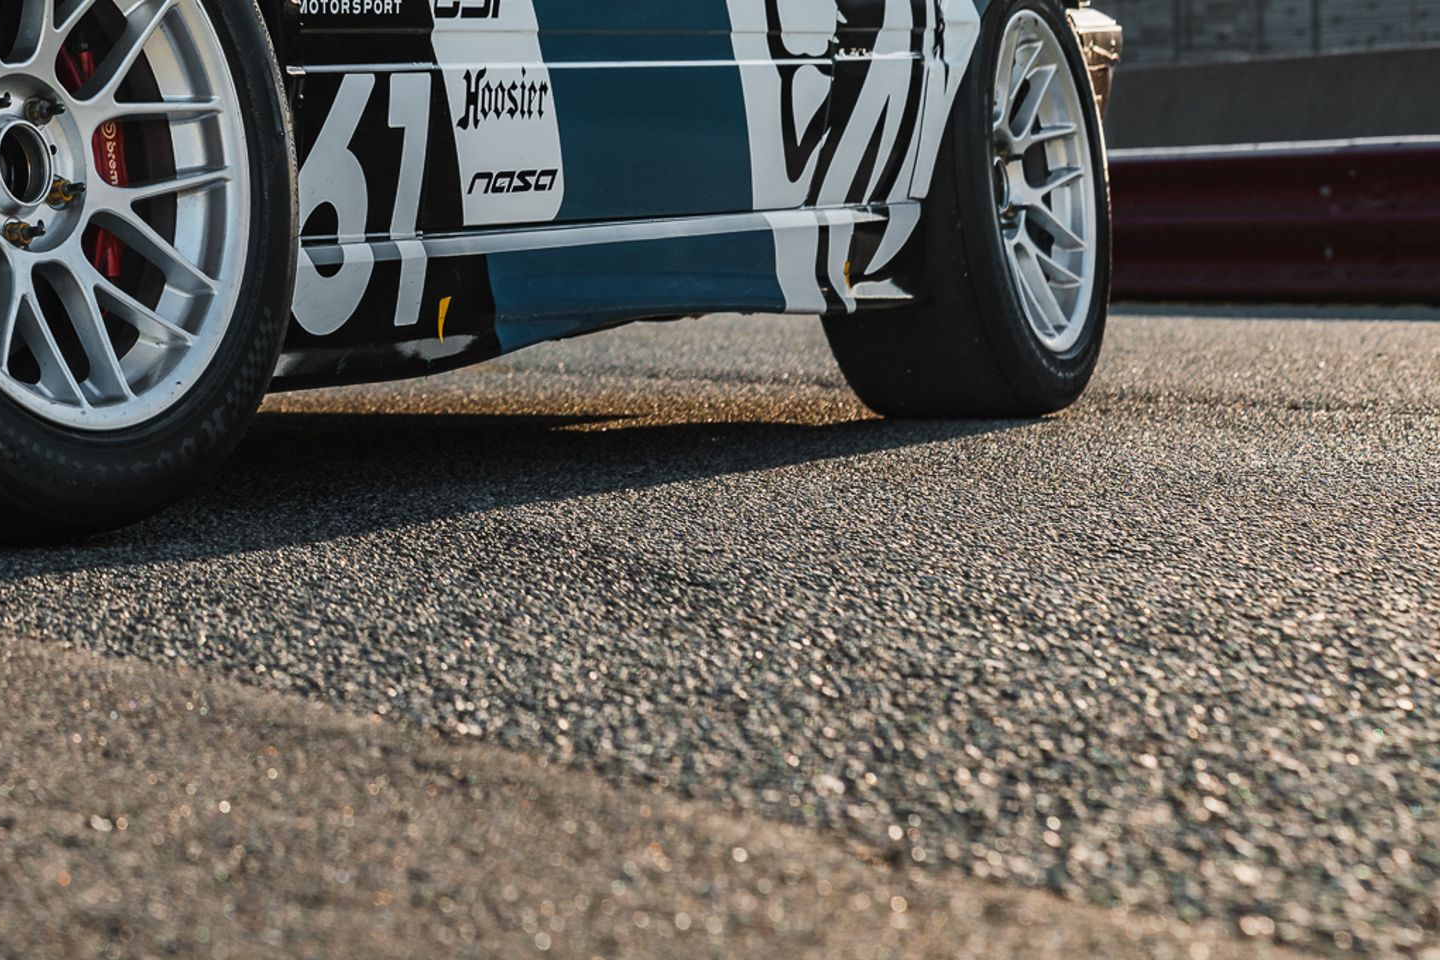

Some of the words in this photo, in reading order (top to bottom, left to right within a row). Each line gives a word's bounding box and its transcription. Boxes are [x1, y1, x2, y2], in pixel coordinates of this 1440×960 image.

[456, 66, 548, 130] Hoosier
[291, 72, 432, 336] 61
[467, 169, 559, 195] nasa
